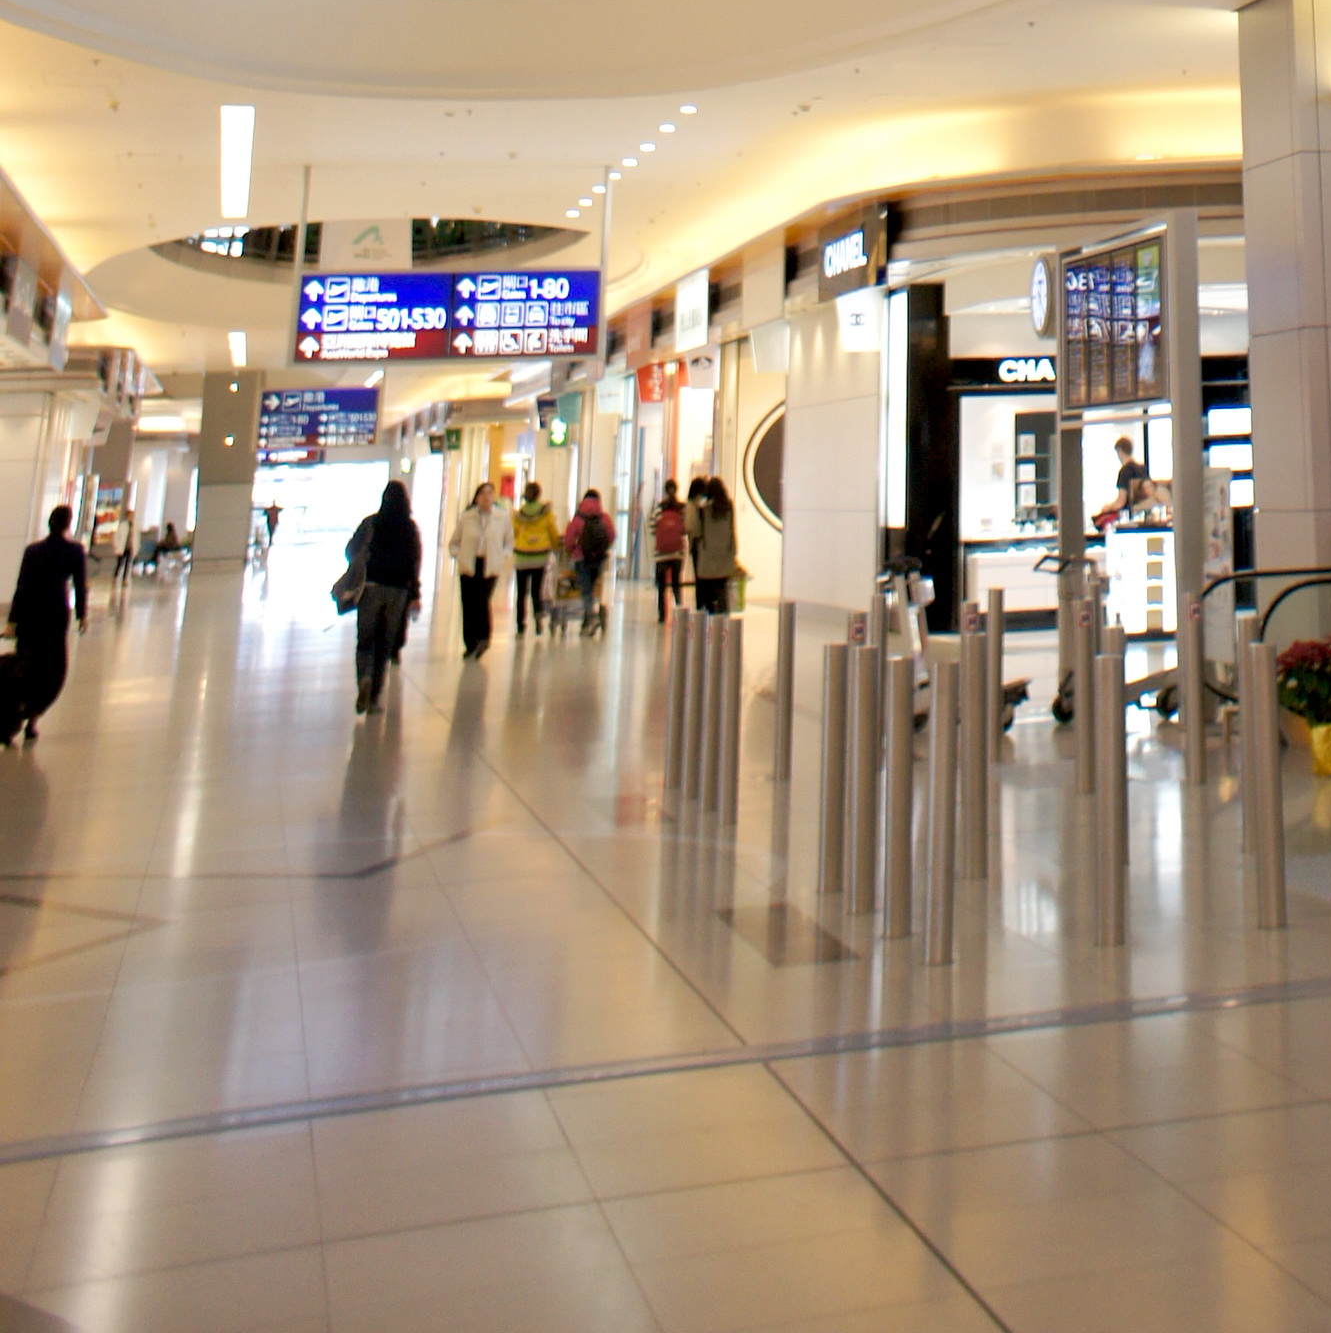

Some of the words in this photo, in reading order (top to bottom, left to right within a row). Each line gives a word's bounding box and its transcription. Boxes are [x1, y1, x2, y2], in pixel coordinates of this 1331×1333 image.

[824, 231, 868, 278] CHANEL
[529, 277, 570, 300] 1-80
[376, 306, 447, 331] 501-530
